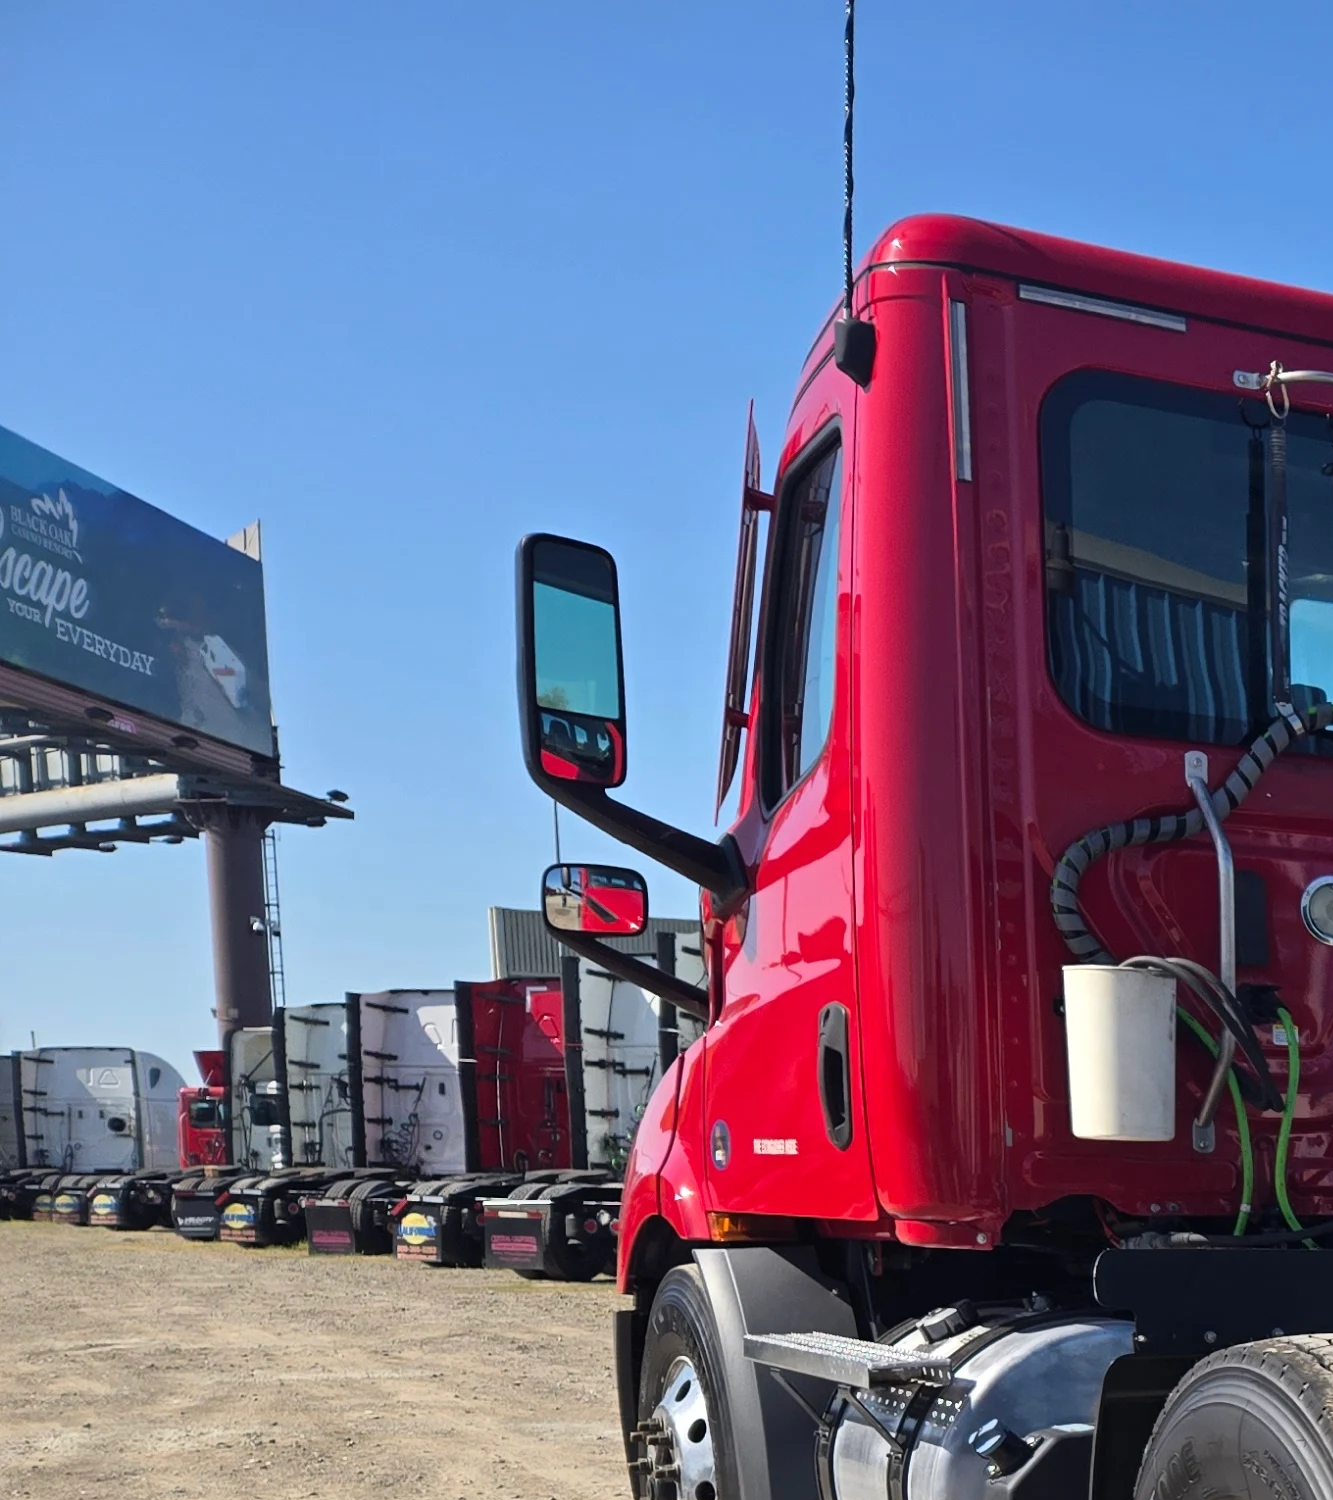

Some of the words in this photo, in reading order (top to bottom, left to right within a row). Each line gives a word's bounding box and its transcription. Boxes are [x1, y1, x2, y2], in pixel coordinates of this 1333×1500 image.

[9, 504, 48, 537] BLACK
[48, 523, 73, 549] OAK
[0, 545, 90, 629] scape
[6, 597, 43, 625] YOUR
[55, 617, 156, 676] EVERYDAY
